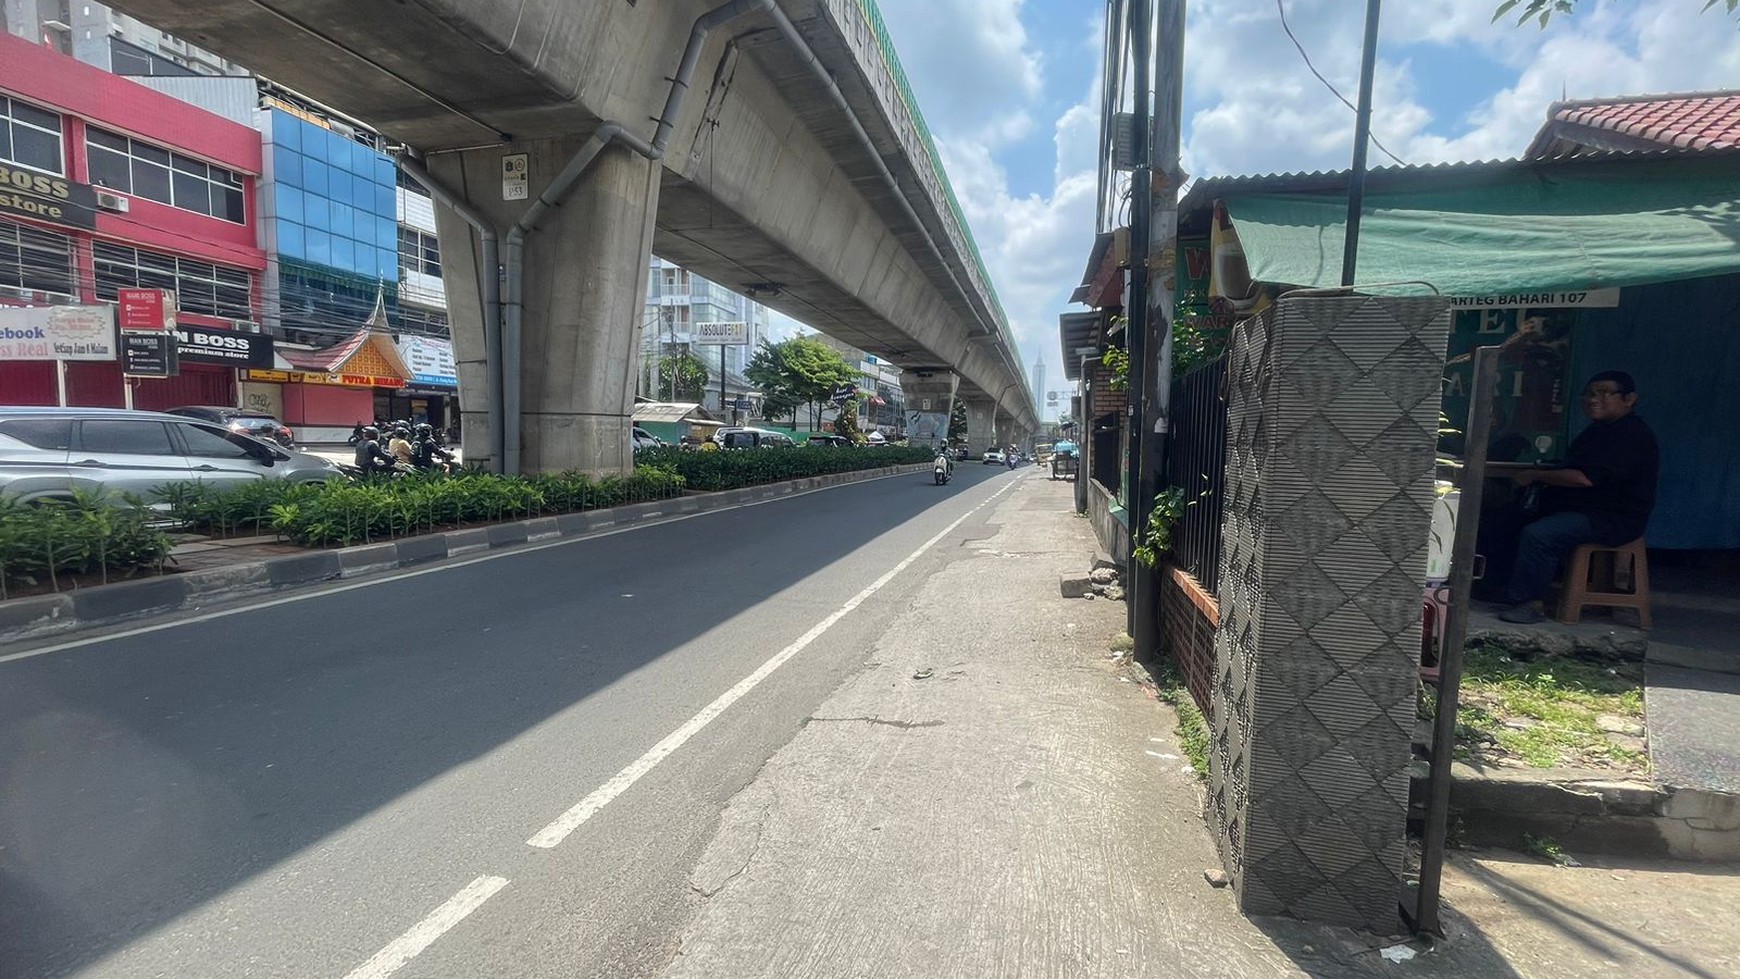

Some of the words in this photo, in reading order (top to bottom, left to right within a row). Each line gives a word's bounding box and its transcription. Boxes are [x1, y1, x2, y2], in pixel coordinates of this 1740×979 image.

[0, 194, 62, 218] store
[1498, 293, 1555, 305] BAHARI
[1560, 292, 1588, 304] 107
[193, 333, 250, 350] BOSS
[177, 347, 224, 358] premium
[225, 351, 250, 360] store
[341, 374, 373, 385] PUTRA
